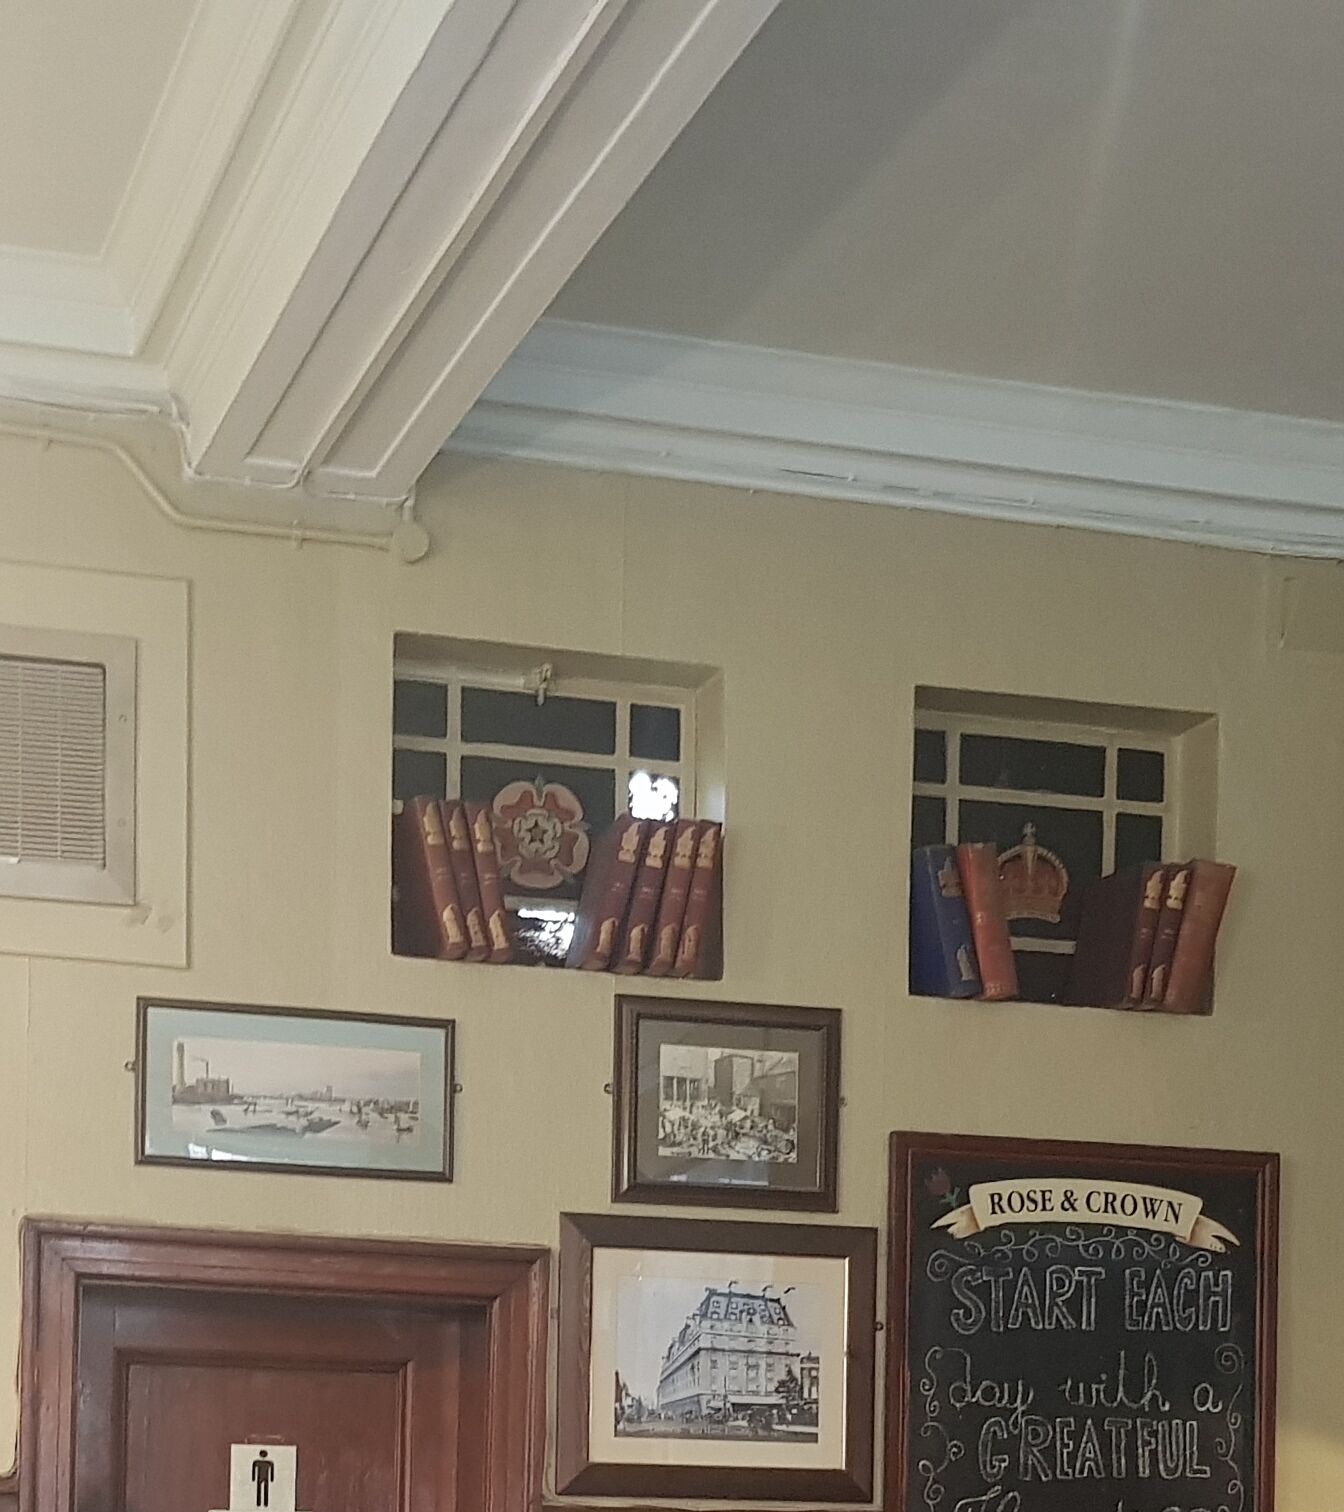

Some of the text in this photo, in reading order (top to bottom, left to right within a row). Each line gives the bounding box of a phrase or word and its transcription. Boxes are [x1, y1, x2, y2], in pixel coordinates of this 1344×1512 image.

[988, 1190, 1184, 1225] ROSE & CROWN
[950, 1264, 1233, 1334] START EACH
[949, 1347, 1223, 1435] day with a
[978, 1415, 1211, 1482] GREATFUL
